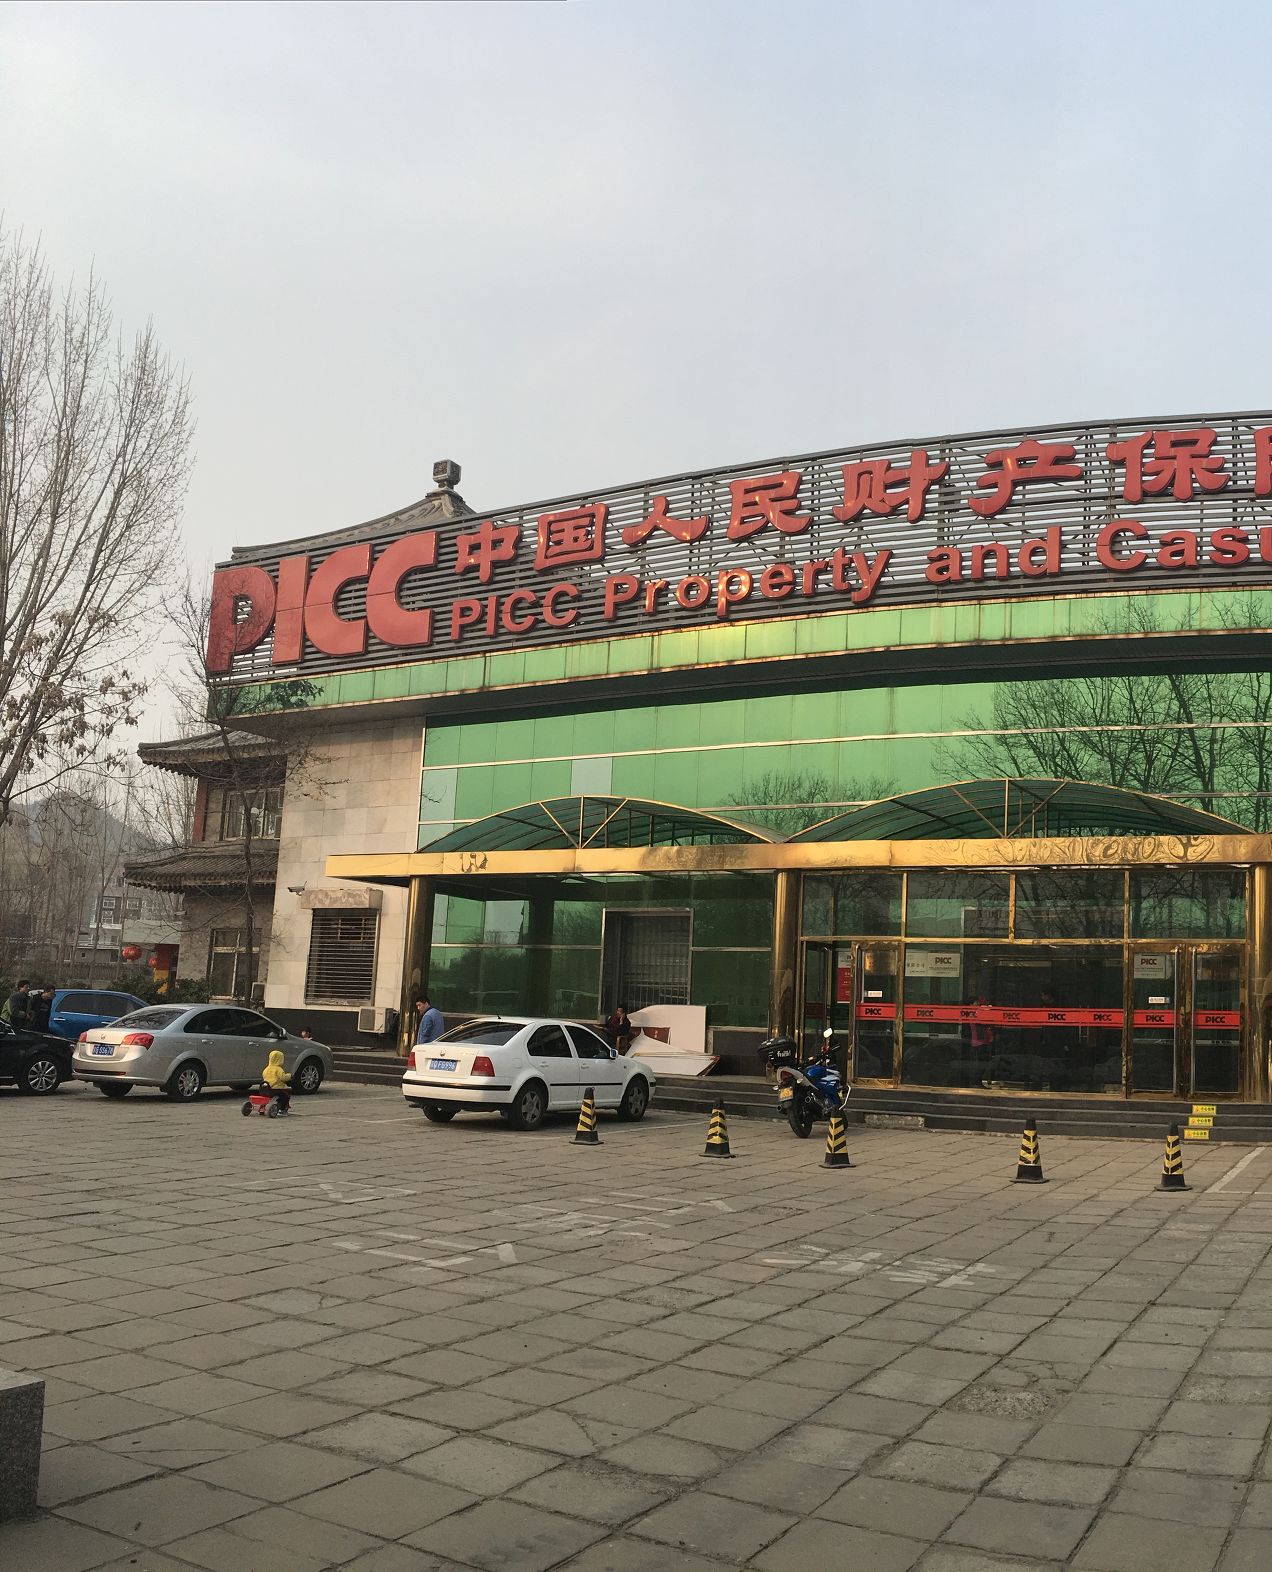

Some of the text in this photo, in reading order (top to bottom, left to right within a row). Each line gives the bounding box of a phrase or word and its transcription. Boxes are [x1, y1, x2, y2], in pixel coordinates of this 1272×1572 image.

[450, 582, 579, 641] PICC
[603, 547, 892, 619] Property
[924, 525, 1062, 584] and
[207, 530, 438, 673] PICC
[865, 1008, 882, 1016] PICC
[916, 1009, 934, 1017] PICC
[1048, 1013, 1066, 1021] PICC
[1093, 1013, 1112, 1022] PICC
[1145, 1015, 1164, 1023] PICC
[1205, 1016, 1226, 1024] PICC
